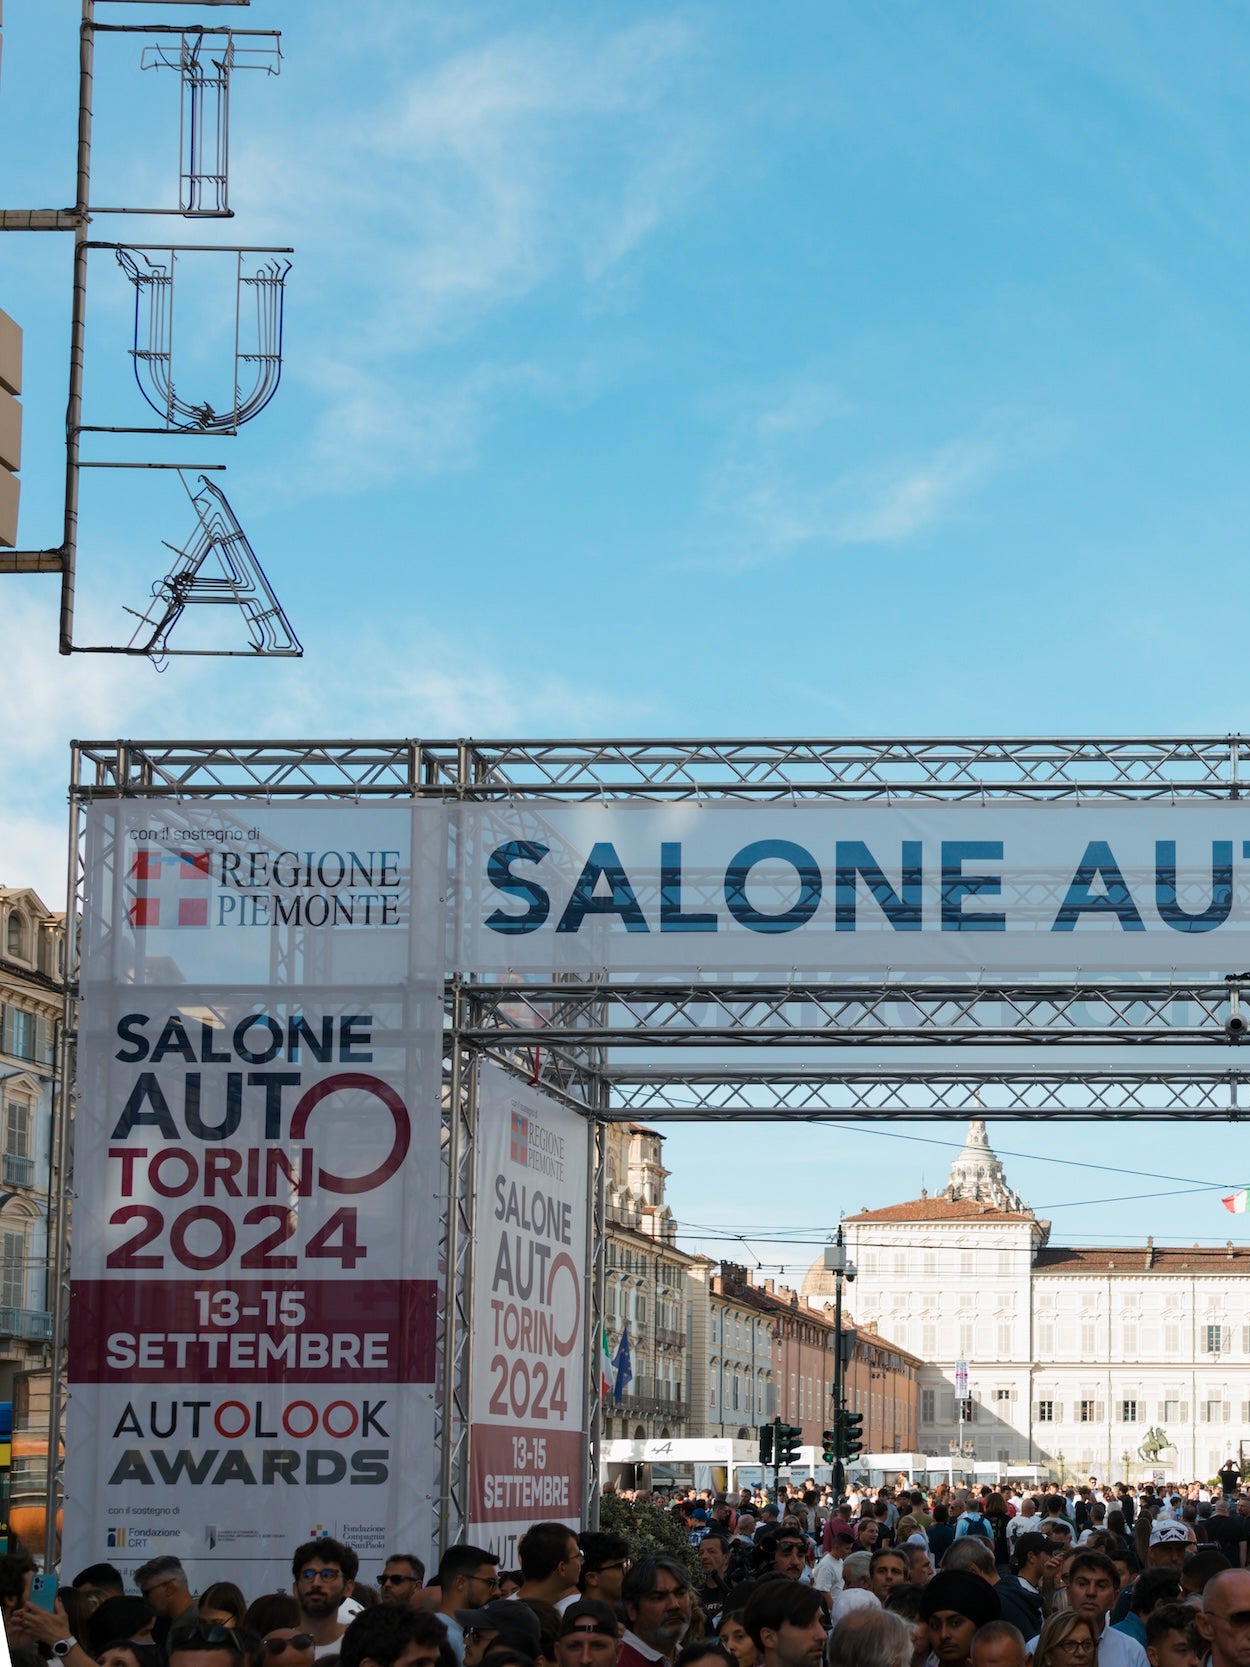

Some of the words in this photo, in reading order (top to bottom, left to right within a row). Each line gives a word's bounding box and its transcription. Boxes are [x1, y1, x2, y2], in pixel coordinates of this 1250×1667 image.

[130, 829, 157, 840] con
[162, 827, 169, 840] il
[174, 828, 243, 844] sostegno
[248, 827, 260, 840] di
[219, 851, 400, 888] REGIONE
[483, 839, 1006, 935] SALONE
[219, 894, 400, 928] PIEMONTE
[115, 1014, 373, 1064] SALONE
[528, 1122, 564, 1159] REGIONE
[528, 1148, 564, 1182] PIEMONTE
[494, 1174, 571, 1245] SALONE
[106, 1204, 367, 1271] 2024
[194, 1290, 307, 1327] 13-15
[106, 1332, 389, 1369] SETTEMBRE
[489, 1354, 567, 1421] 2024
[112, 1400, 390, 1439] AUTOLOOK
[108, 1449, 389, 1485] AWARDS
[512, 1436, 546, 1470] 13-15
[484, 1474, 569, 1509] SETTEMBRE
[132, 1507, 171, 1516] sostegno
[172, 1506, 180, 1514] di
[343, 1524, 385, 1532] Fondazione
[128, 1528, 180, 1537] Fondazione
[128, 1539, 148, 1548] CRT
[342, 1533, 384, 1542] Compagnia
